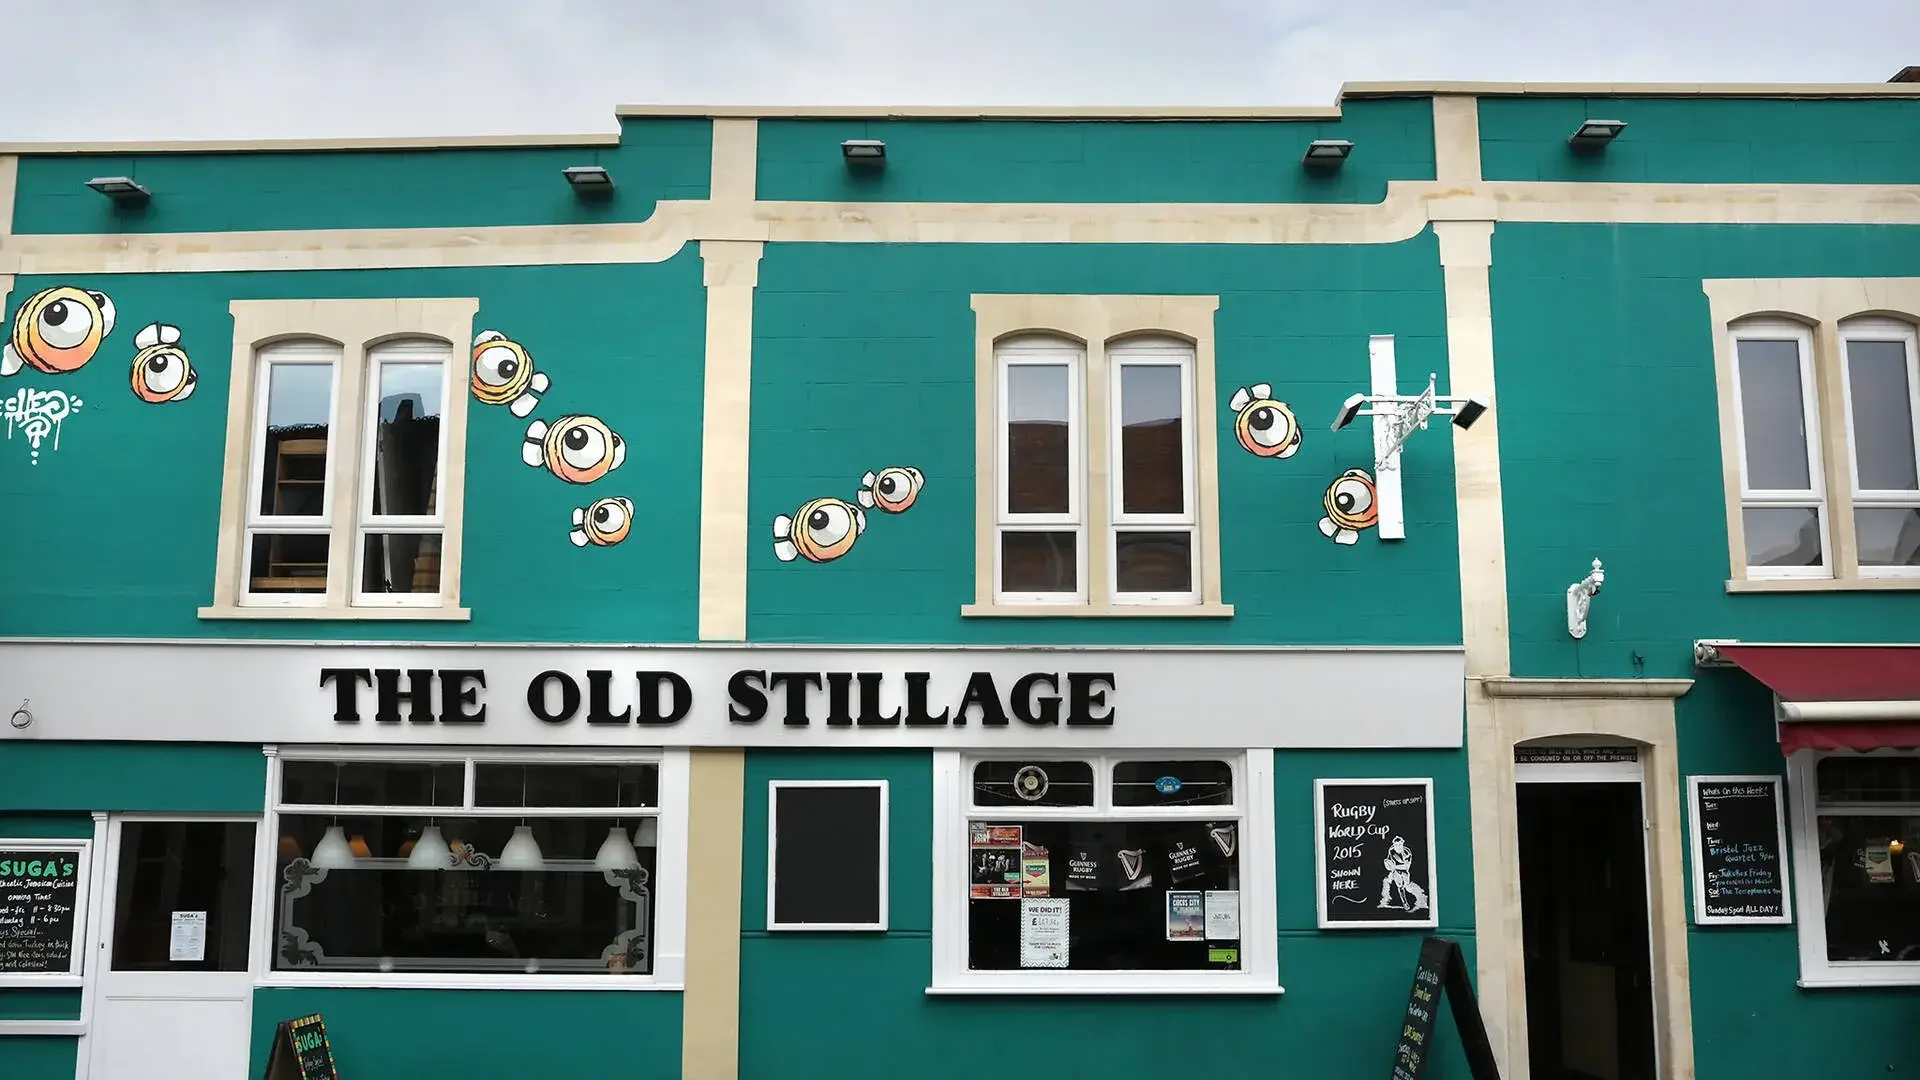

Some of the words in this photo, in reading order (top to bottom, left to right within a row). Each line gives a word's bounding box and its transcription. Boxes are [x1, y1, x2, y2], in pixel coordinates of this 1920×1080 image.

[320, 668, 487, 726] THE
[527, 669, 692, 728] OLD
[728, 669, 1116, 729] STILLAGE
[1330, 803, 1376, 823] RUGBY
[1328, 824, 1366, 840] WORLD
[1169, 848, 1197, 860] GUINNESS
[1332, 843, 1364, 861] 2015
[1709, 843, 1739, 856] Bristol
[1742, 843, 1764, 853] Jazz
[1069, 859, 1097, 867] GUINNESS
[1174, 854, 1193, 864] RUGBY
[0, 858, 74, 877] SUGA's
[1330, 866, 1361, 879] SHOWN
[1332, 880, 1359, 890] HERE
[1053, 906, 1062, 914] IT!
[1707, 904, 1728, 915] Sunday
[1728, 906, 1744, 915] Sport
[1745, 904, 1759, 914] ALL
